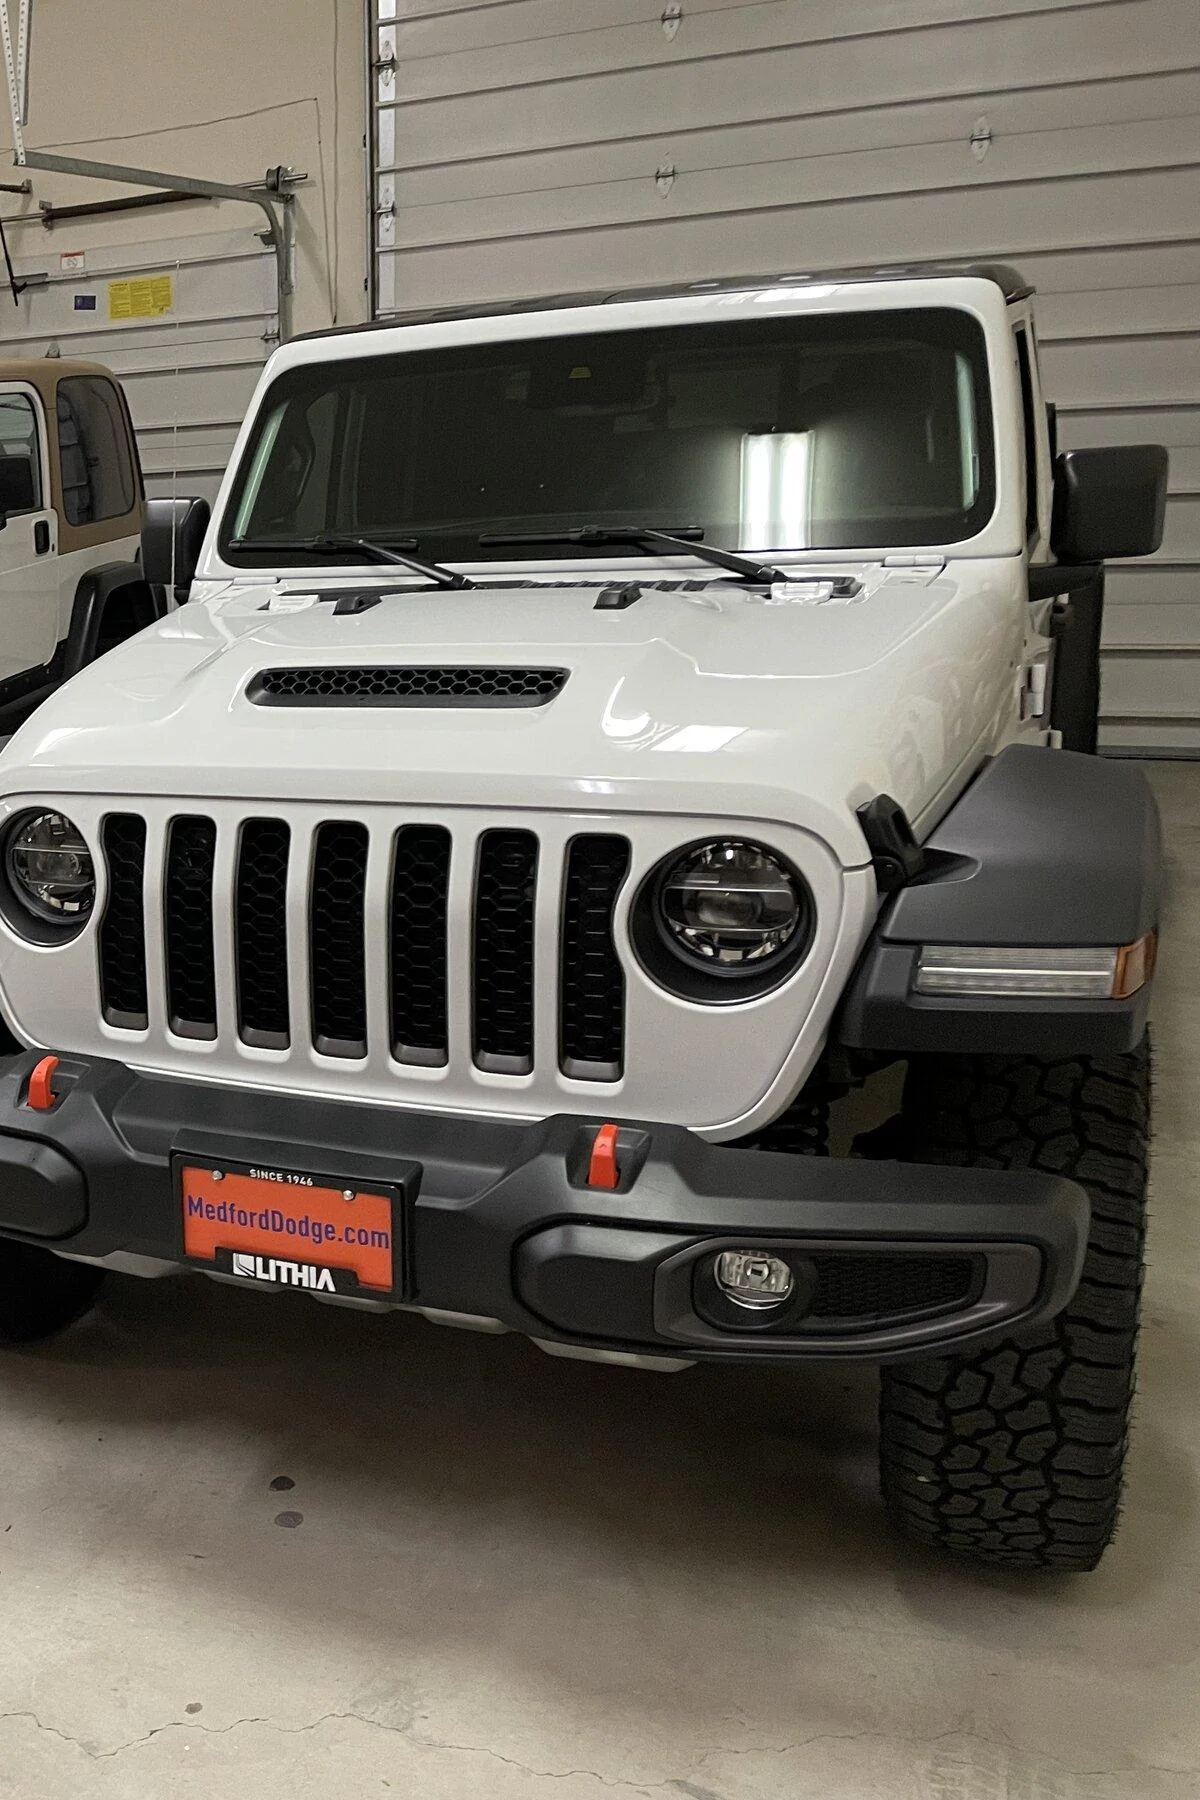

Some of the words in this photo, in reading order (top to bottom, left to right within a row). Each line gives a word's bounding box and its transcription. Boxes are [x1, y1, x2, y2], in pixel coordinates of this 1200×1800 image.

[249, 1168, 284, 1182] SINCE
[286, 1174, 314, 1187] 1946
[187, 1195, 390, 1249] MedfordDodge.com
[255, 1256, 337, 1292] LITHIA
